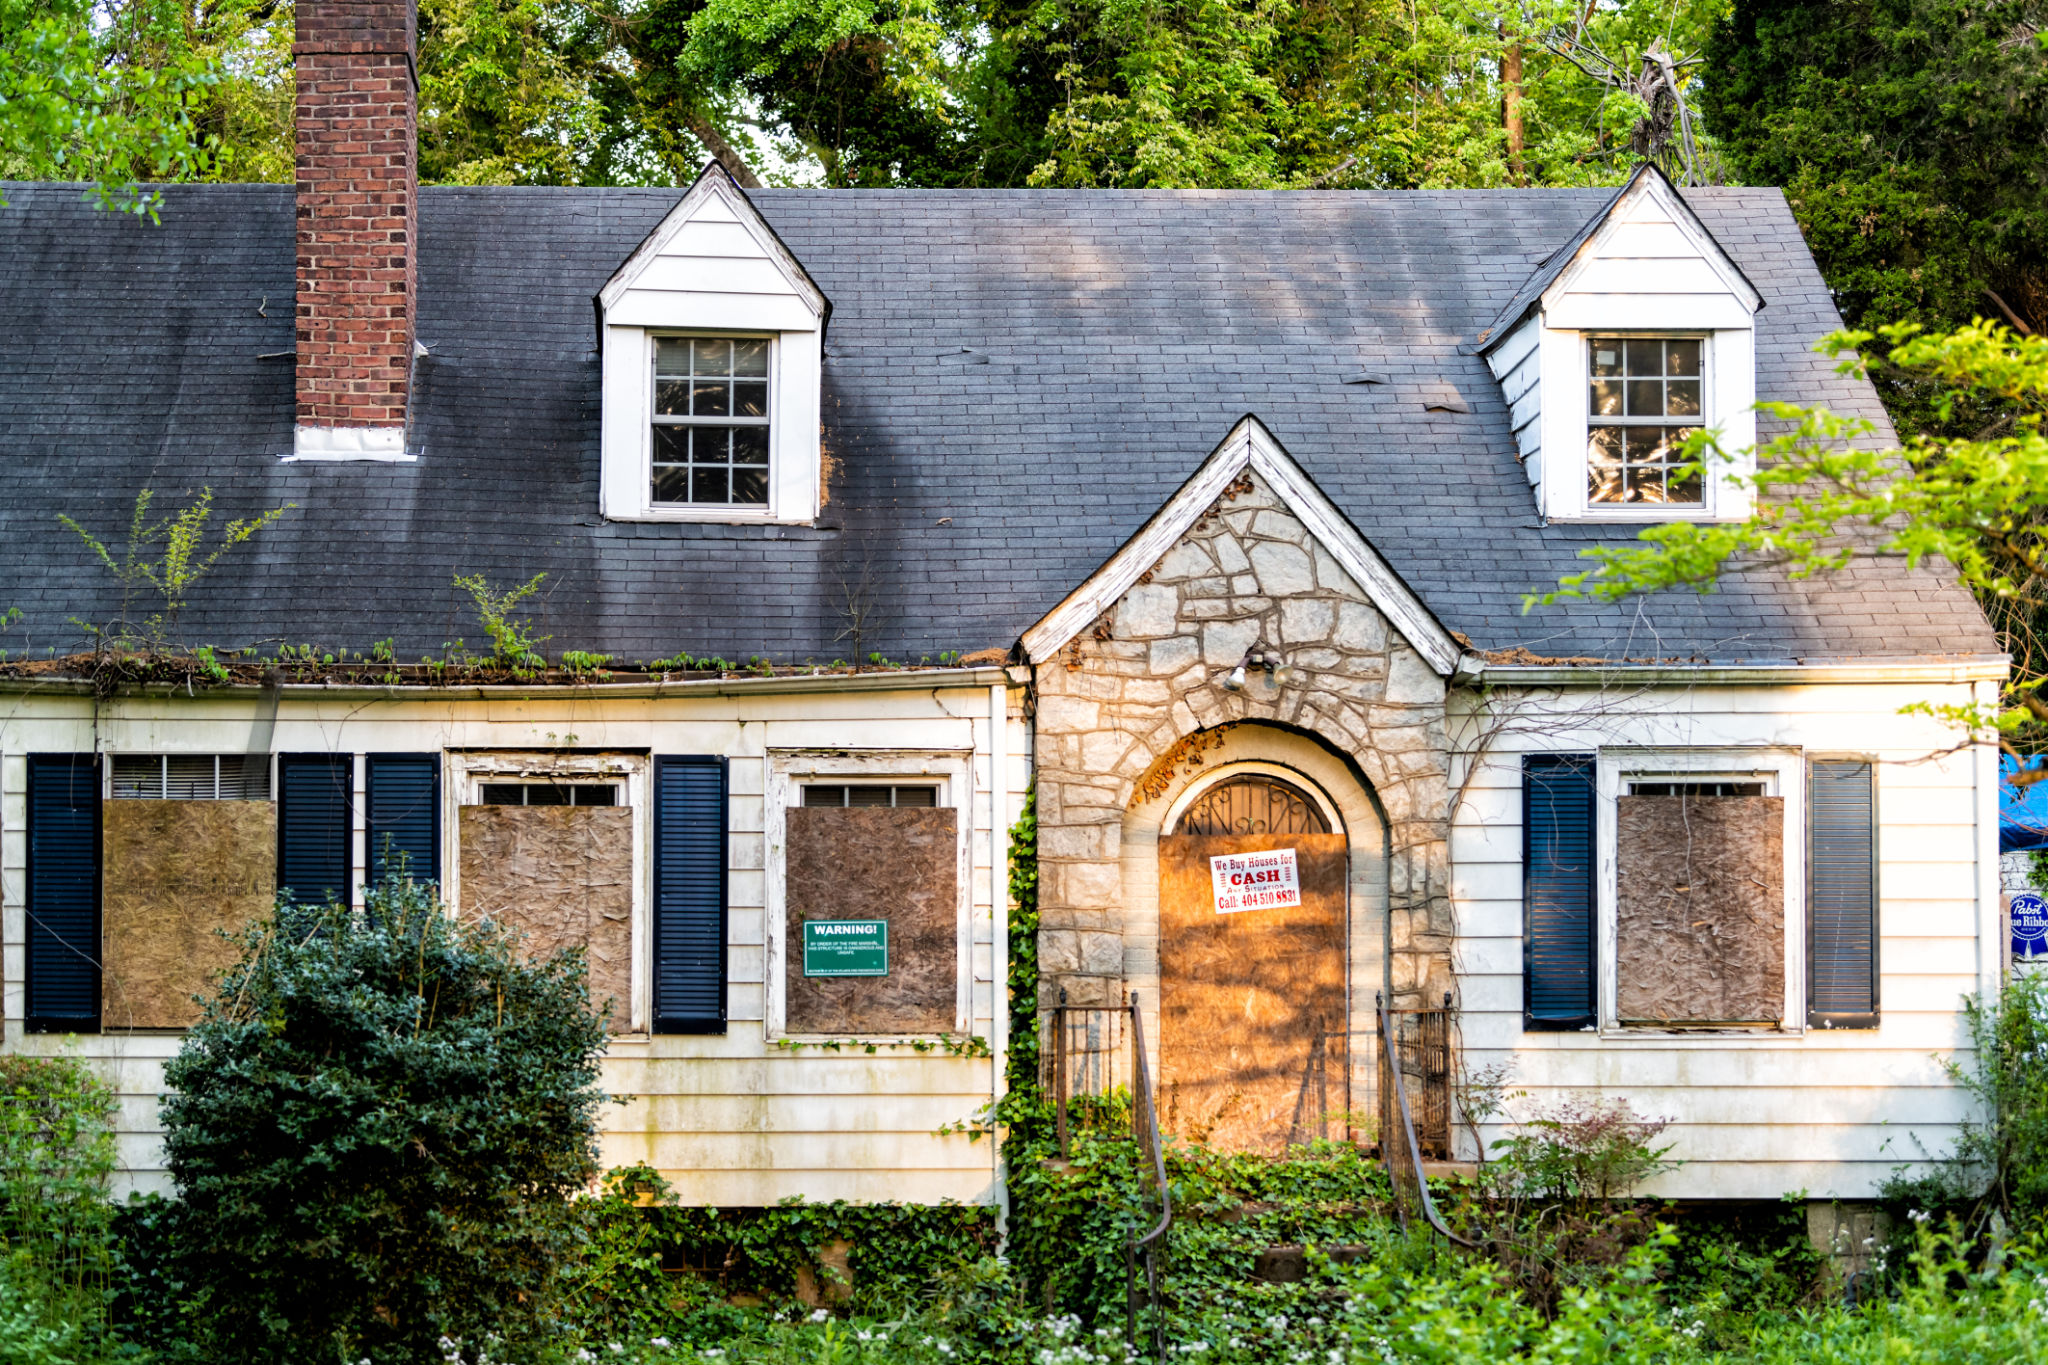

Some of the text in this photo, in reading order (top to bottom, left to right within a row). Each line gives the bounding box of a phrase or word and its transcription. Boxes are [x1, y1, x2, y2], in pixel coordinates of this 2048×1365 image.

[1215, 854, 1293, 871] We Buy Houses for
[1231, 870, 1280, 885] CASH
[1219, 890, 1296, 909] Call: 404 510 8831
[2013, 899, 2043, 914] Pabst
[2023, 916, 2048, 926] Ribbo
[814, 925, 877, 935] WARNING!
